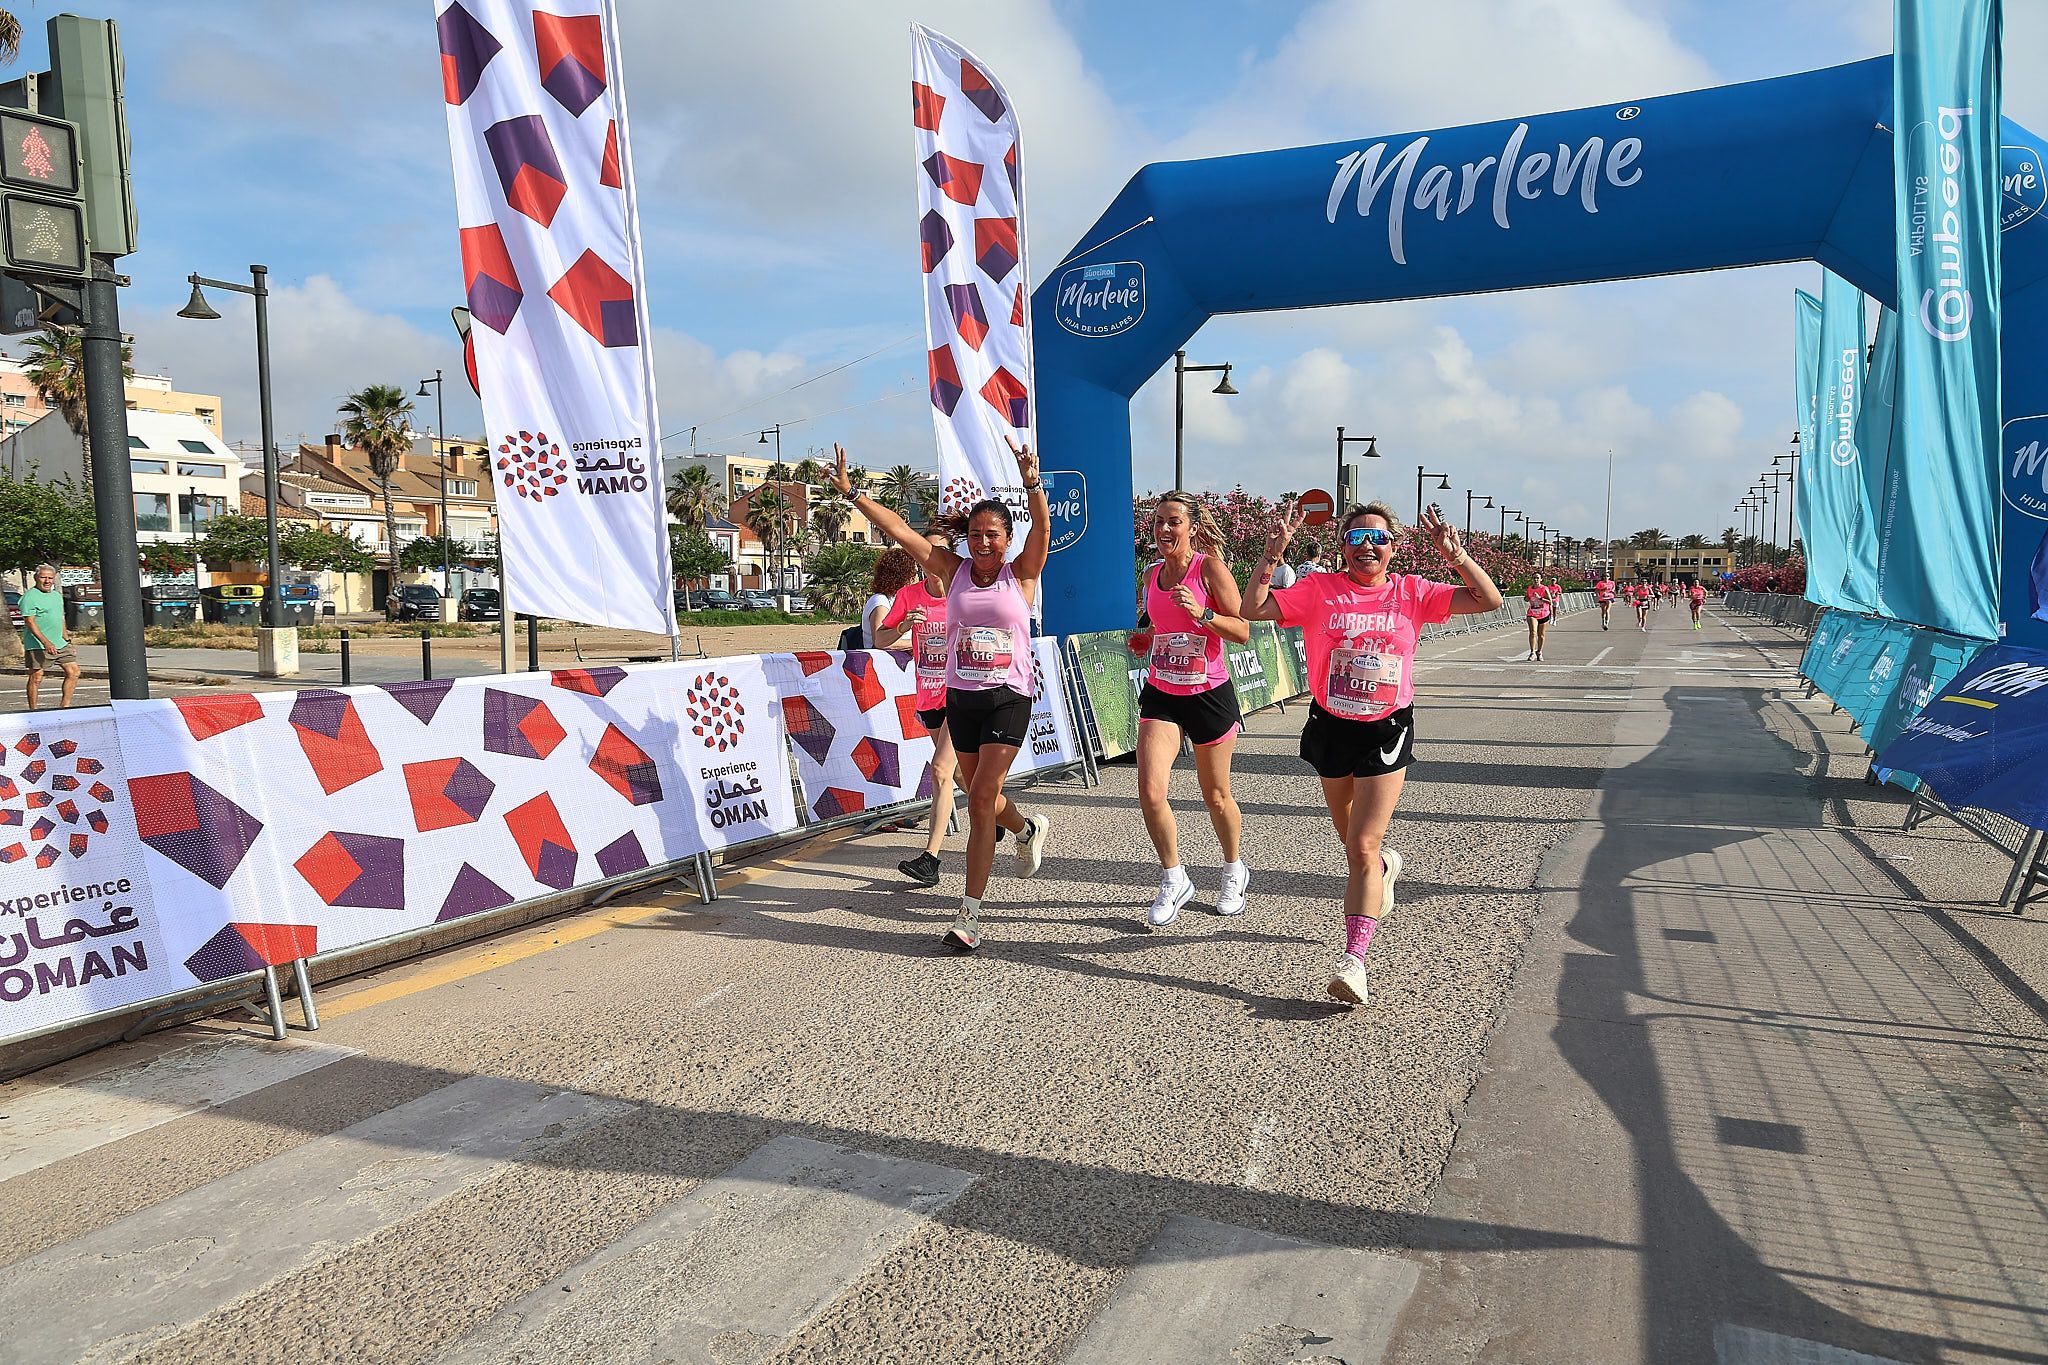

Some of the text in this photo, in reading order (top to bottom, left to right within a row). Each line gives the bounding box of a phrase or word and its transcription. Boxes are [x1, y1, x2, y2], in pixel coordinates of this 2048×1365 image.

[1326, 122, 1644, 265] Marlene
[2000, 205, 2029, 226] LPES
[1062, 279, 1139, 318] Marlene
[1064, 316, 1079, 330] HIJA
[1093, 325, 1109, 333] LOS
[1110, 315, 1133, 331] ALPES
[2020, 493, 2047, 512] HIJA
[1051, 530, 1075, 547] ALPES
[1328, 612, 1396, 633] CARRERA
[928, 654, 946, 662] 016
[972, 651, 994, 661] 016
[1169, 655, 1190, 665] 016
[1350, 678, 1378, 692] 016
[1032, 739, 1059, 756] OMAN
[701, 761, 757, 780] Experience
[710, 800, 769, 829] OMAN
[0, 878, 131, 917] xperience
[0, 940, 148, 1002] OMAN
